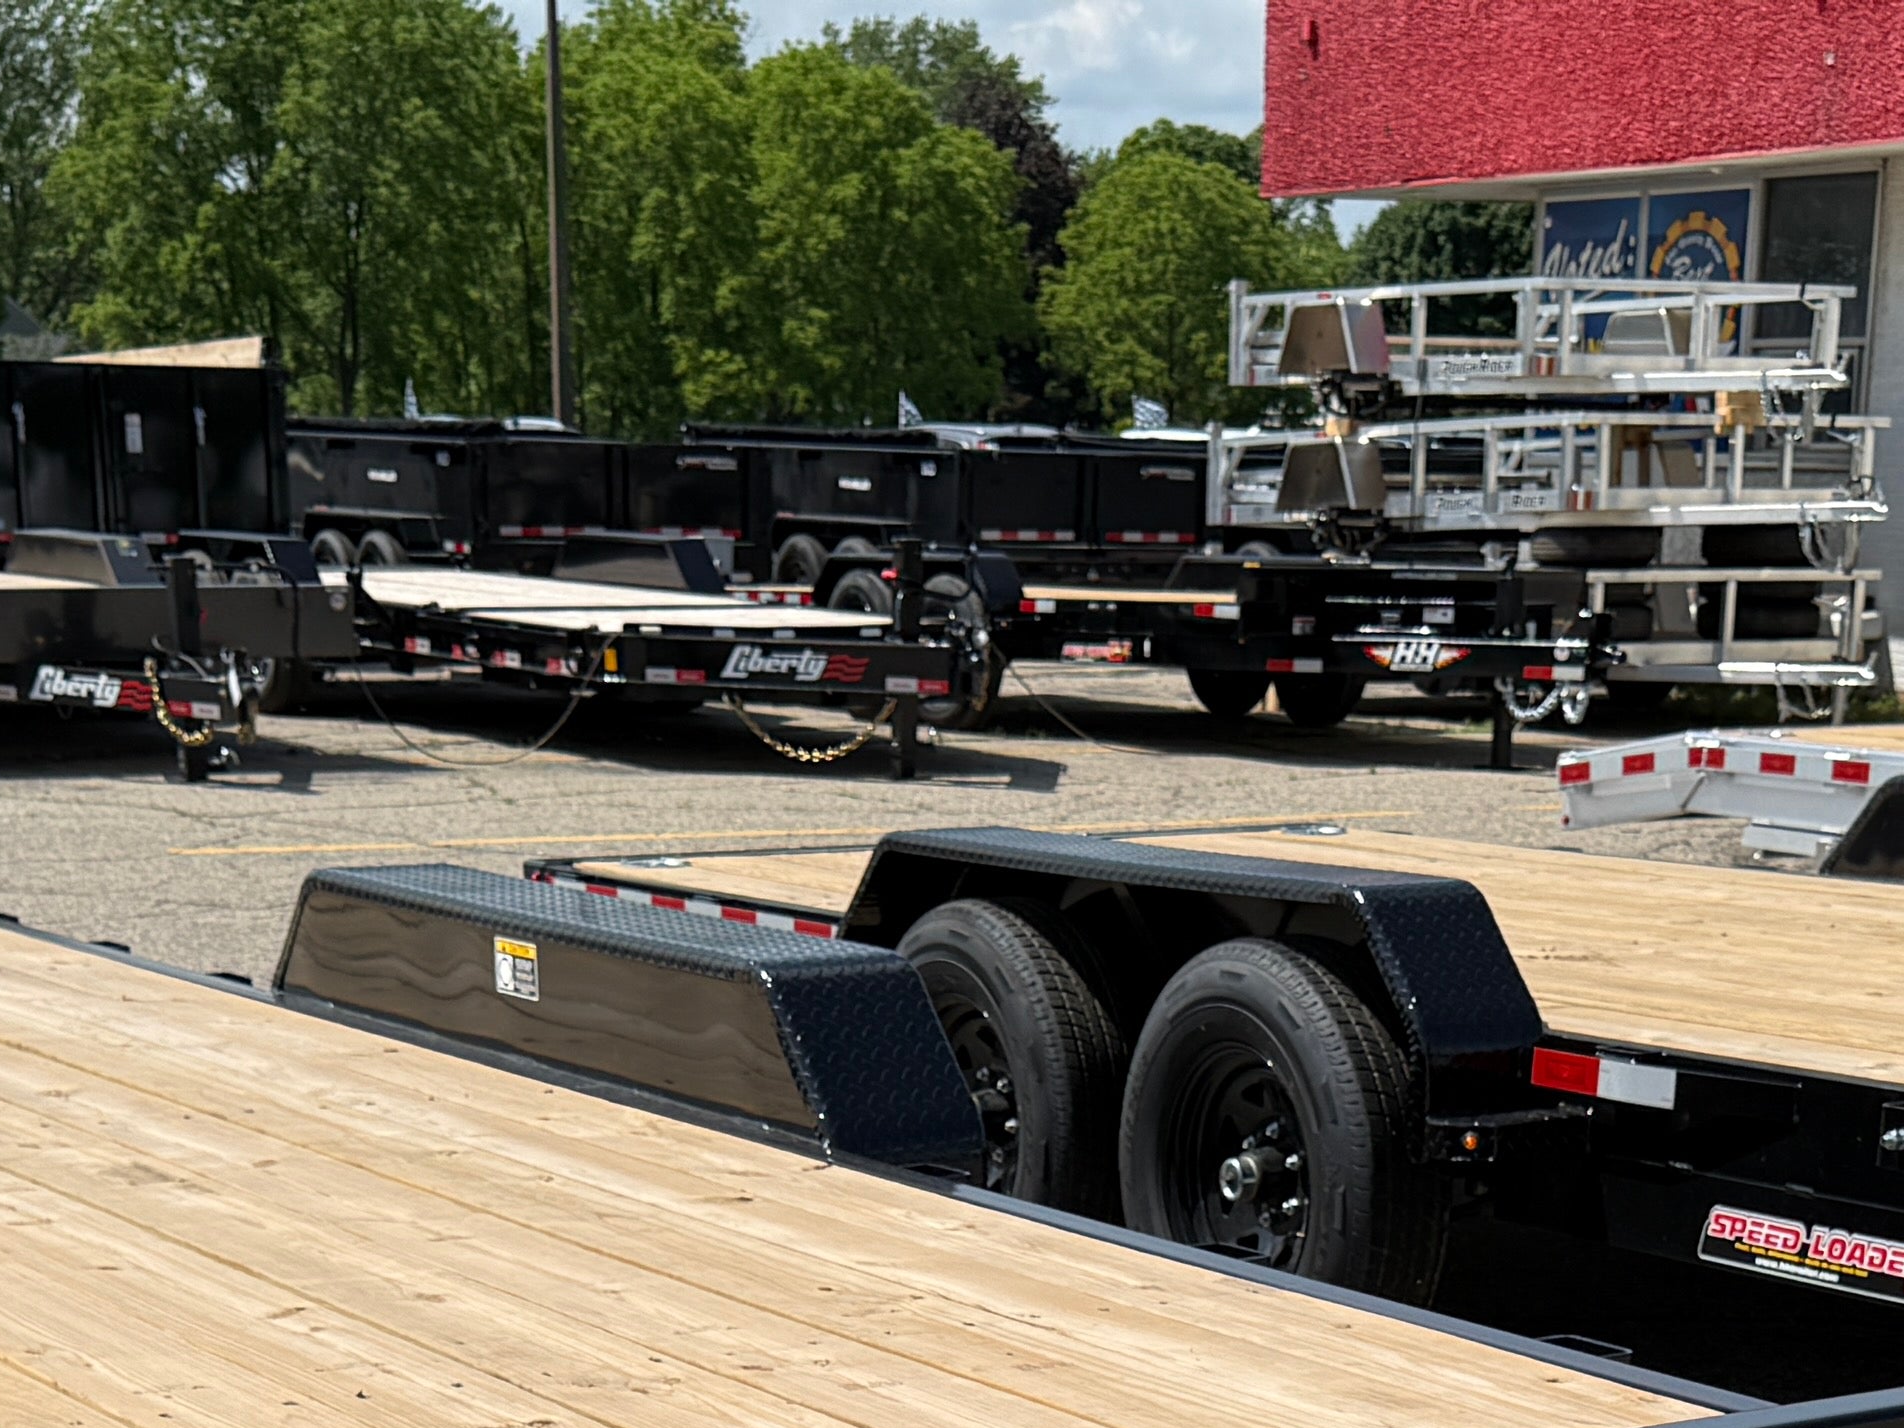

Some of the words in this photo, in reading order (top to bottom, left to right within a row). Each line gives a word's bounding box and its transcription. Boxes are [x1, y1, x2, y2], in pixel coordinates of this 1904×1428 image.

[720, 644, 830, 682] Liberty
[29, 664, 123, 708] Liberty
[1709, 1211, 1803, 1252] SPEED
